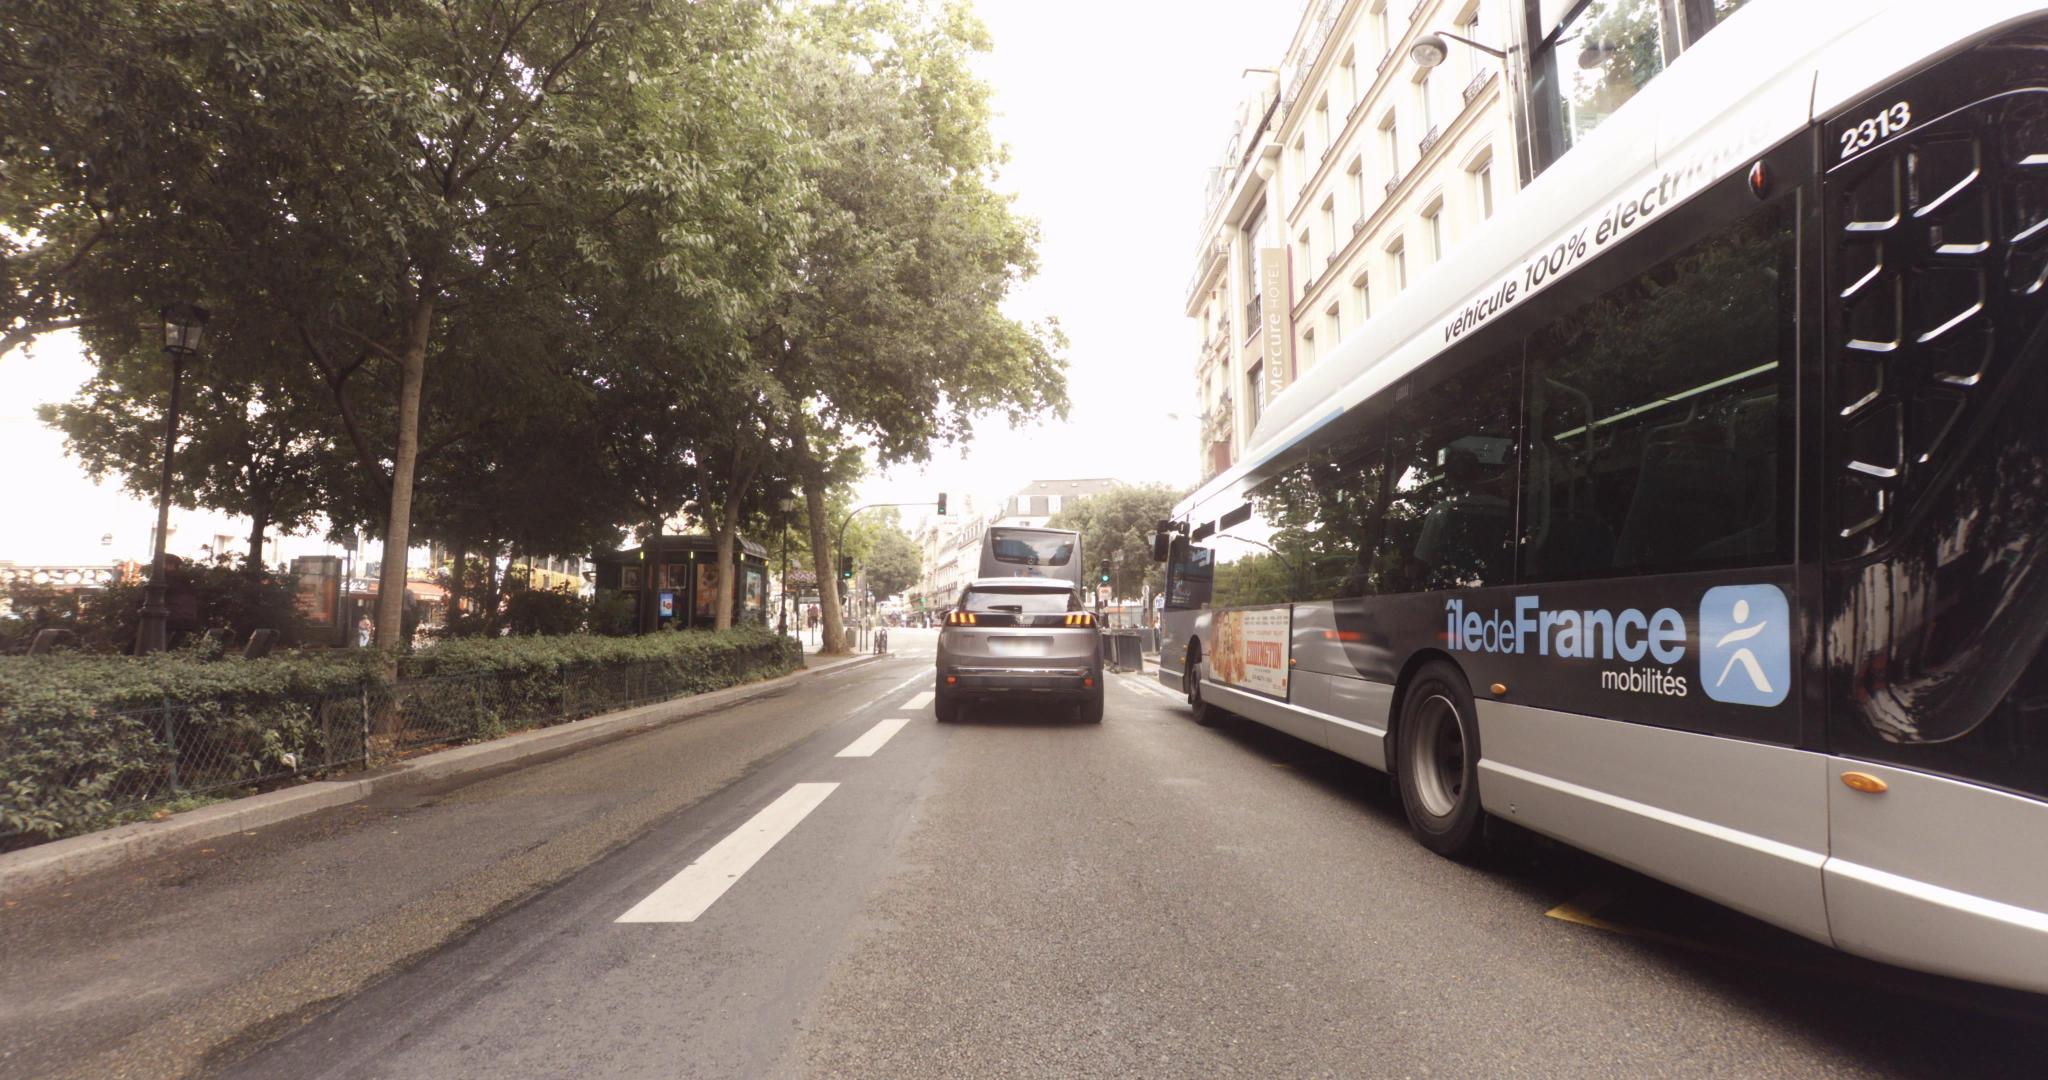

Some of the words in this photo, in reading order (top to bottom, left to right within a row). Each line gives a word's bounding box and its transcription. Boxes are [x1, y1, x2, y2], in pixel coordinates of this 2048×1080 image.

[1841, 100, 1911, 160] 2313
[1268, 263, 1280, 309] HOTEL
[1445, 280, 1517, 342] véhicule
[1525, 227, 1586, 292] 100%
[1270, 313, 1283, 396] Mercure
[1602, 667, 1687, 697] mobilités
